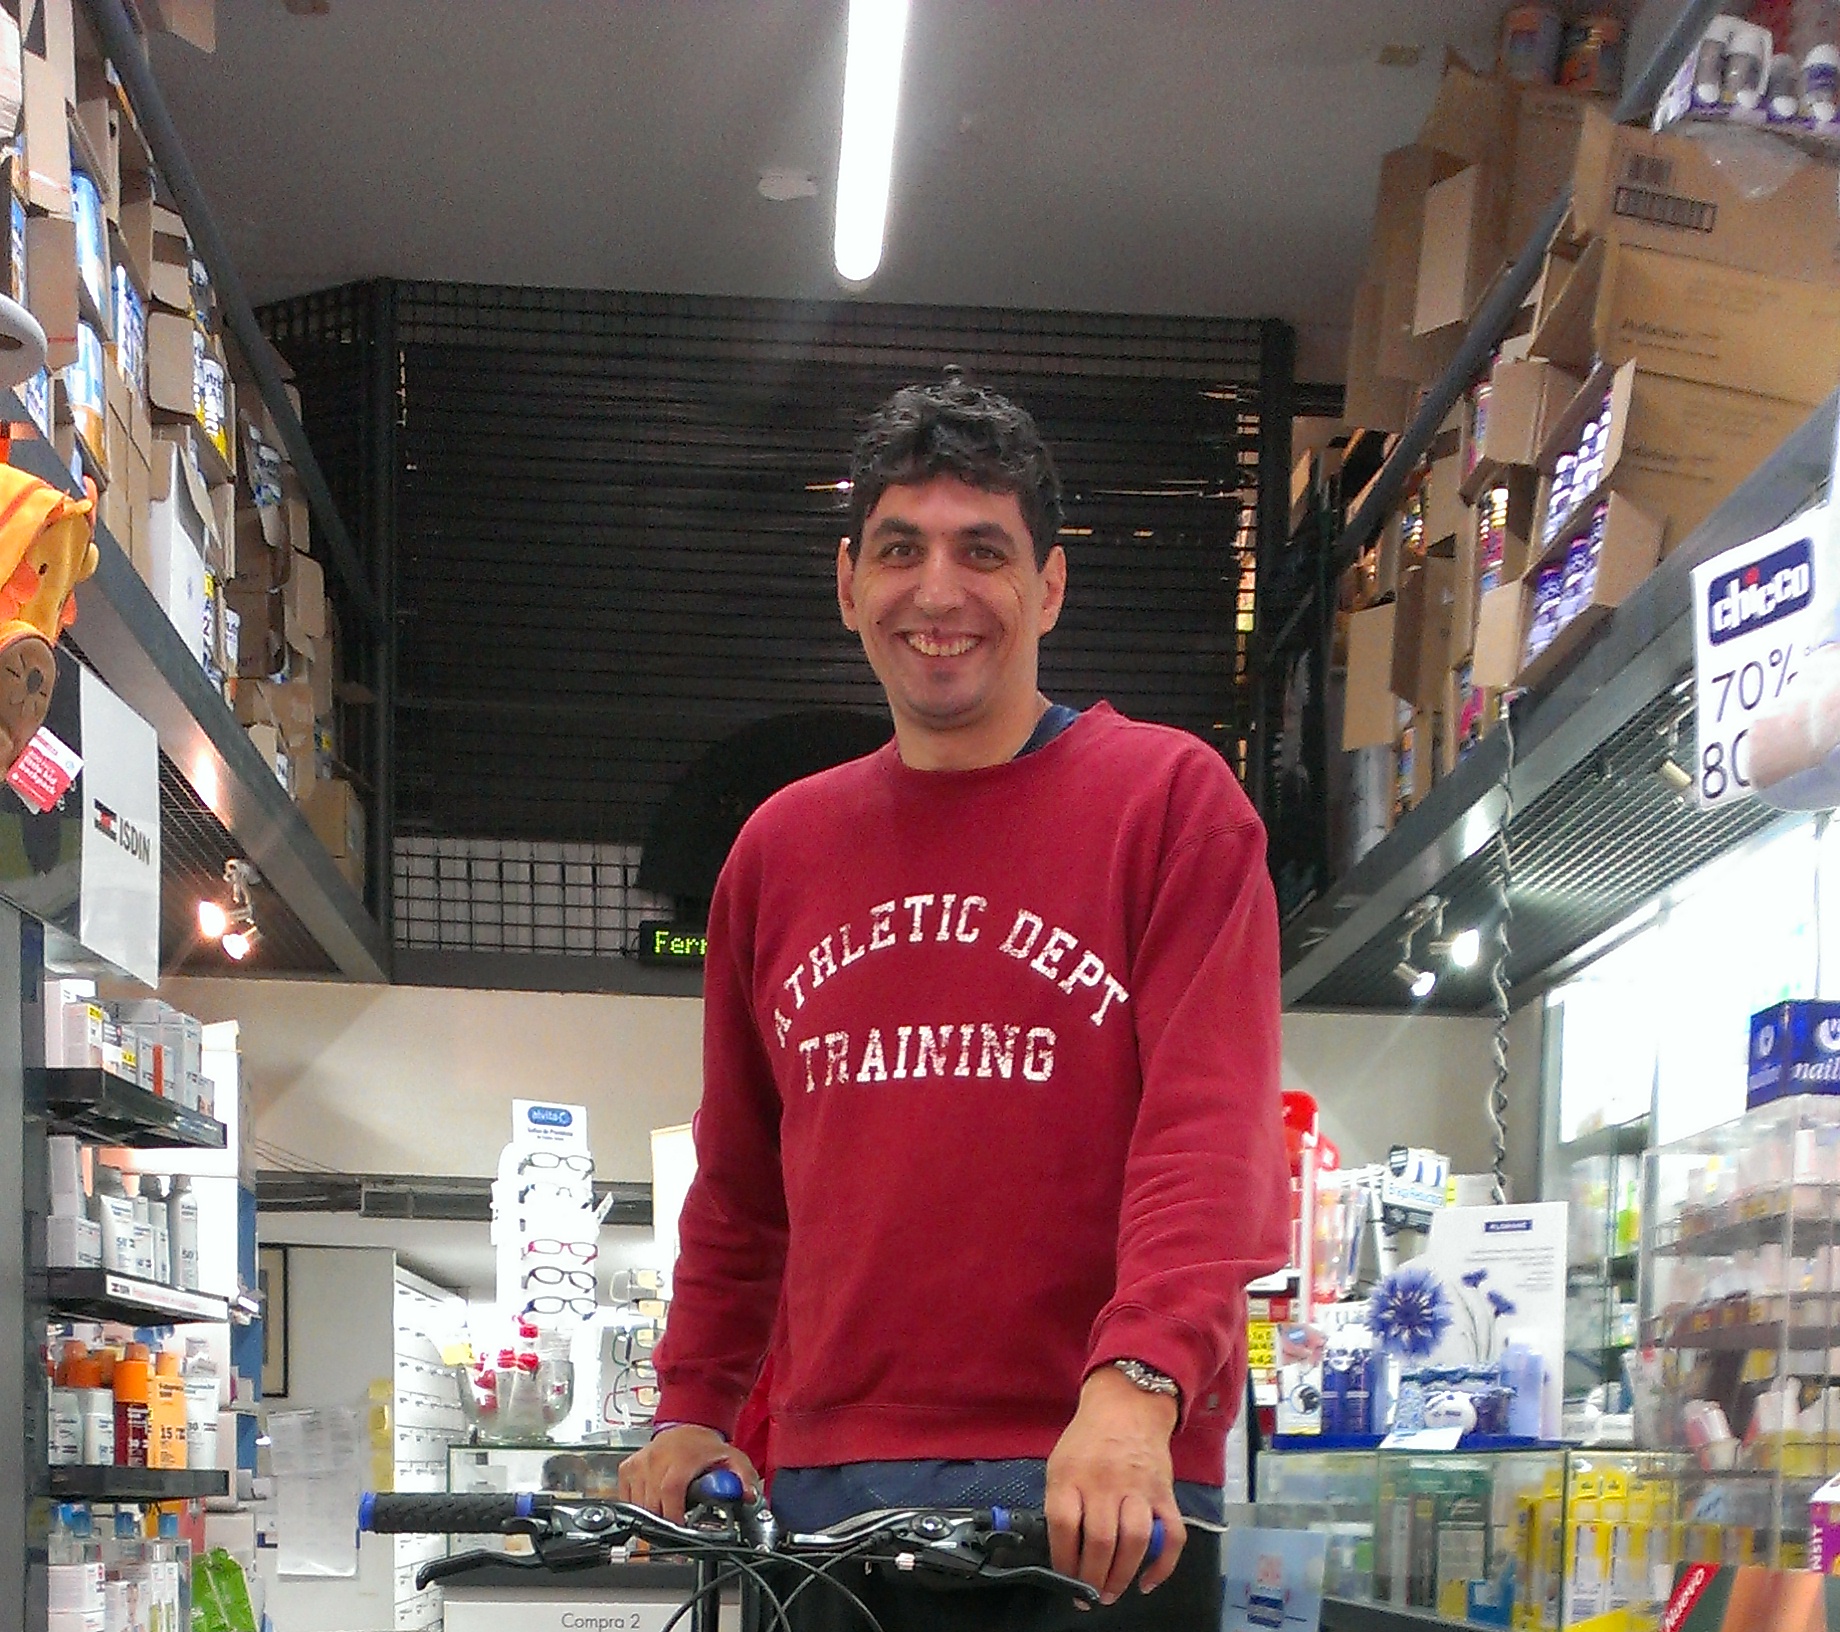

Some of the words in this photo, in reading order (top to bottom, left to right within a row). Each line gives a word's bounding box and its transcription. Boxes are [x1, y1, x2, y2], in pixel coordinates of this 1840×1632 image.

[1712, 562, 1811, 632] chicco
[1712, 644, 1799, 723] 70%
[119, 816, 150, 866] ISDIN
[773, 893, 988, 1049] ATHLETIC
[999, 907, 1130, 1027] DEPT
[799, 1022, 1057, 1093] TRAINING
[561, 1613, 625, 1632] Compra
[630, 1613, 641, 1629] 2
